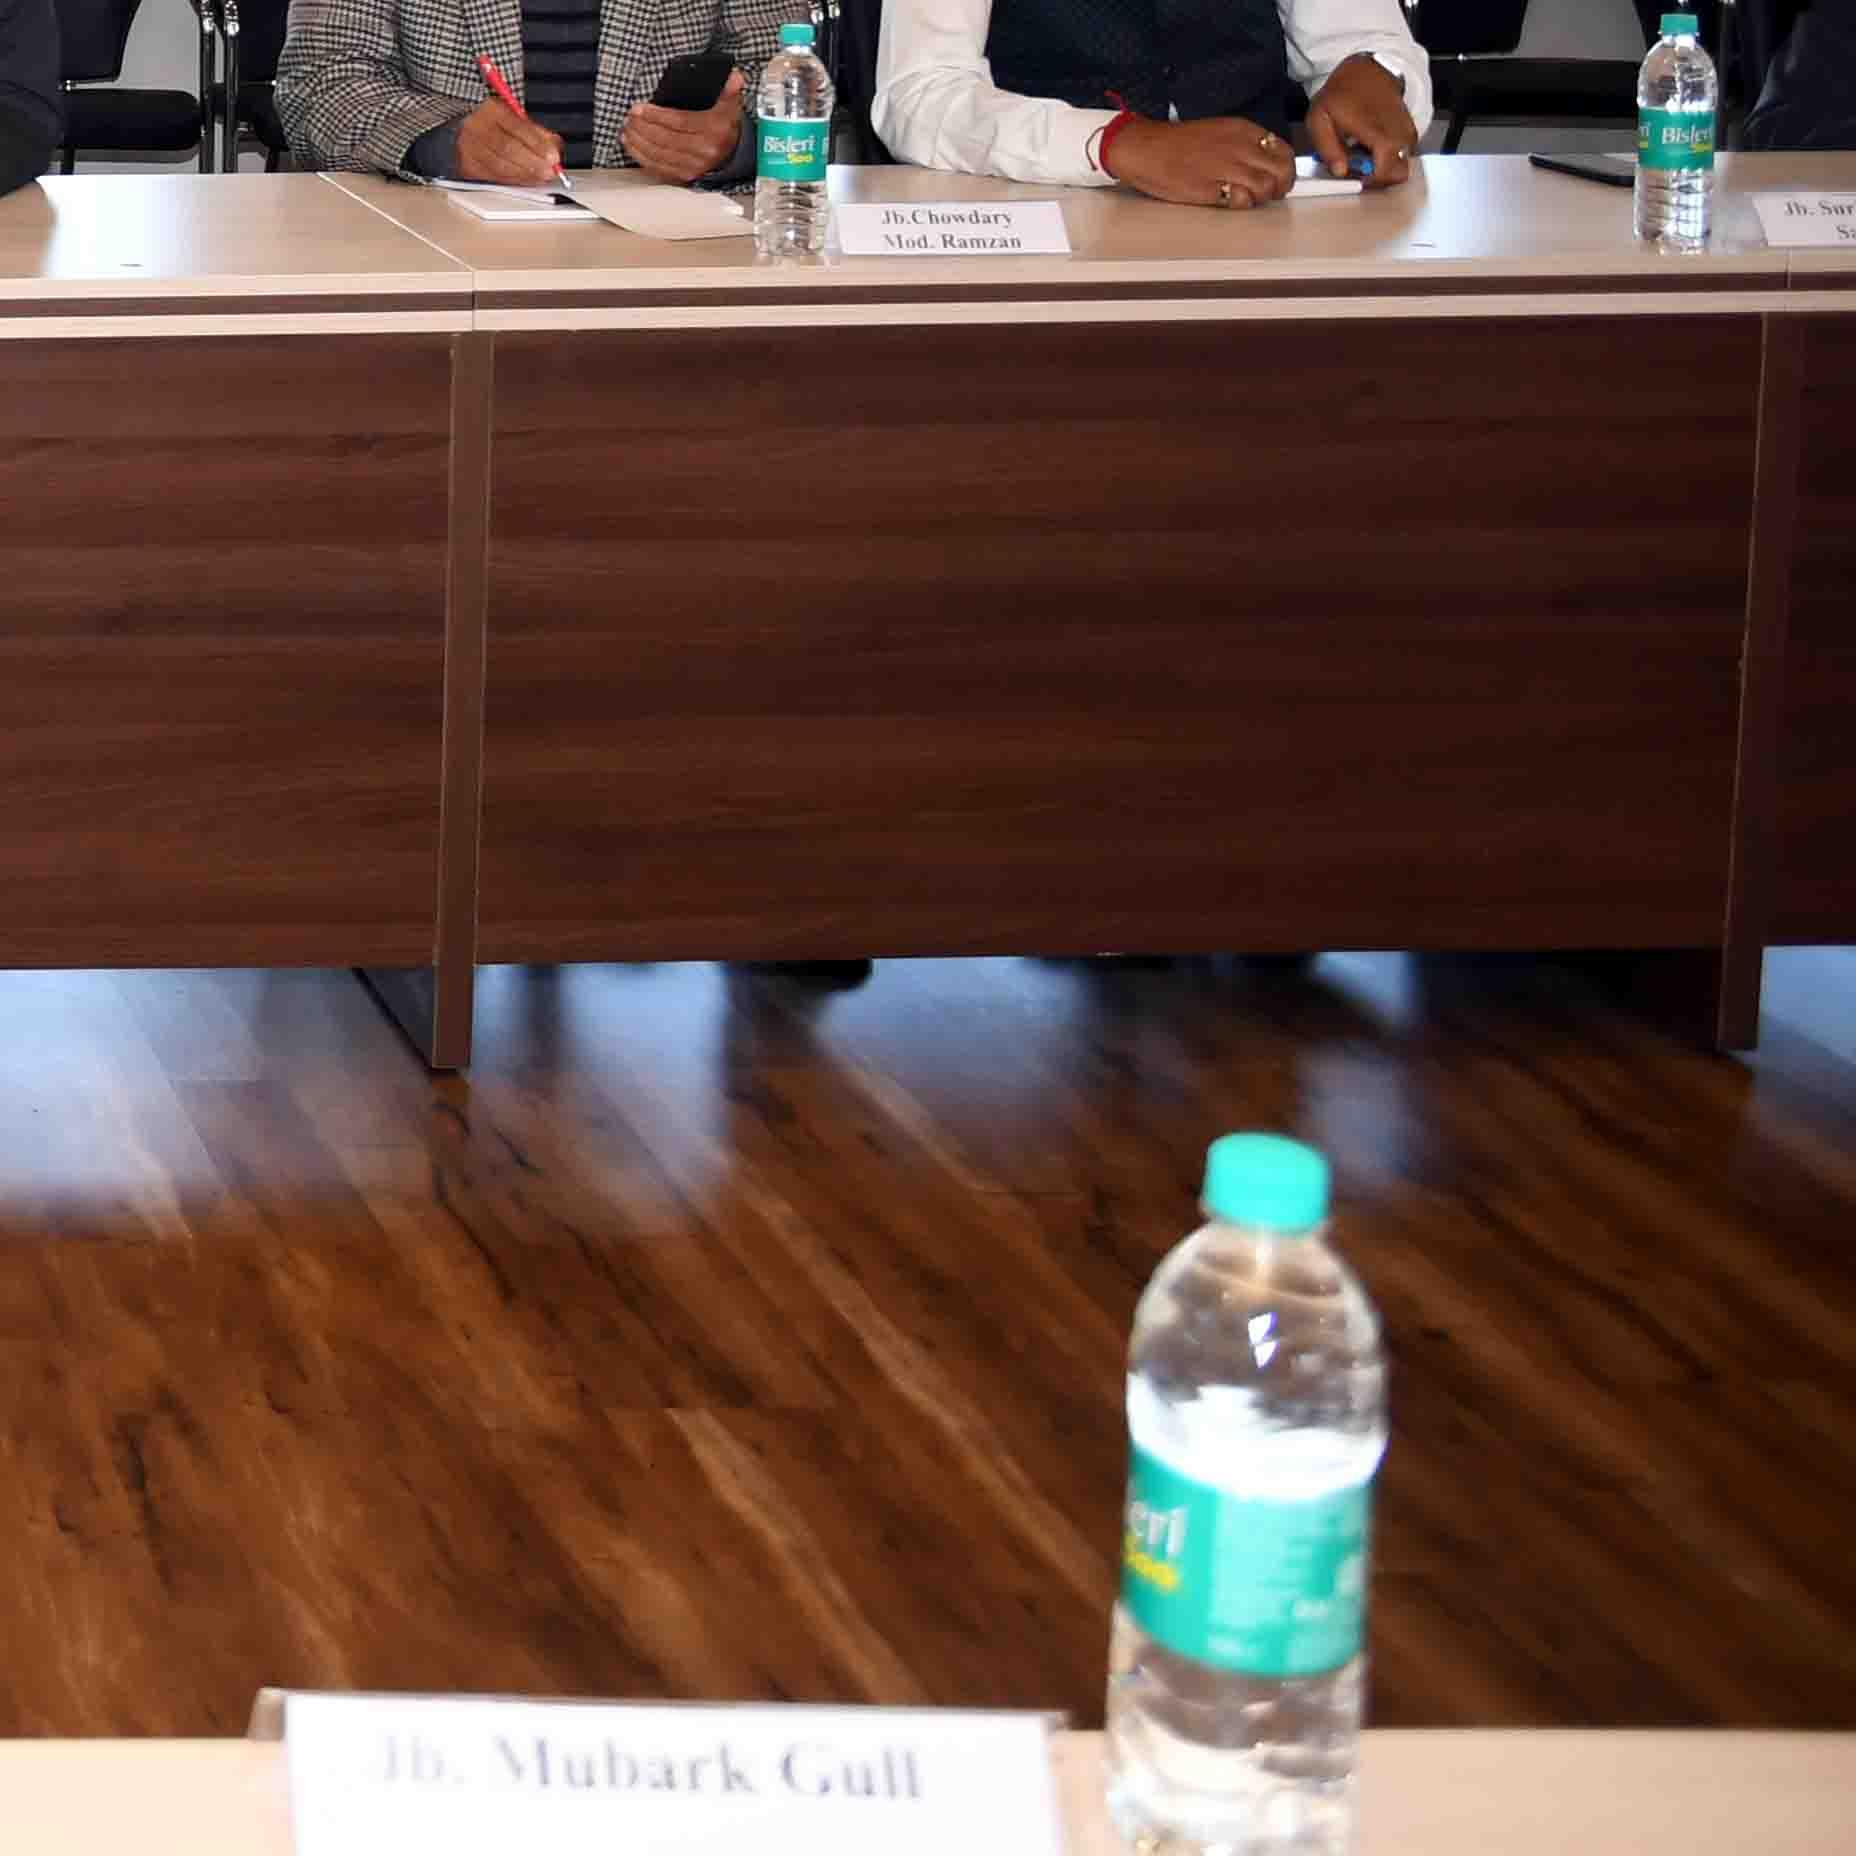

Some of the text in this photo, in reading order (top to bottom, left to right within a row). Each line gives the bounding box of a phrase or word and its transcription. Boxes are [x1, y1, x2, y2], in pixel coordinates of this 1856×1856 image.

[884, 233, 1022, 249] Mod. Ramzan
[493, 1735, 760, 1796] Mubark
[777, 1741, 921, 1802] Gull
